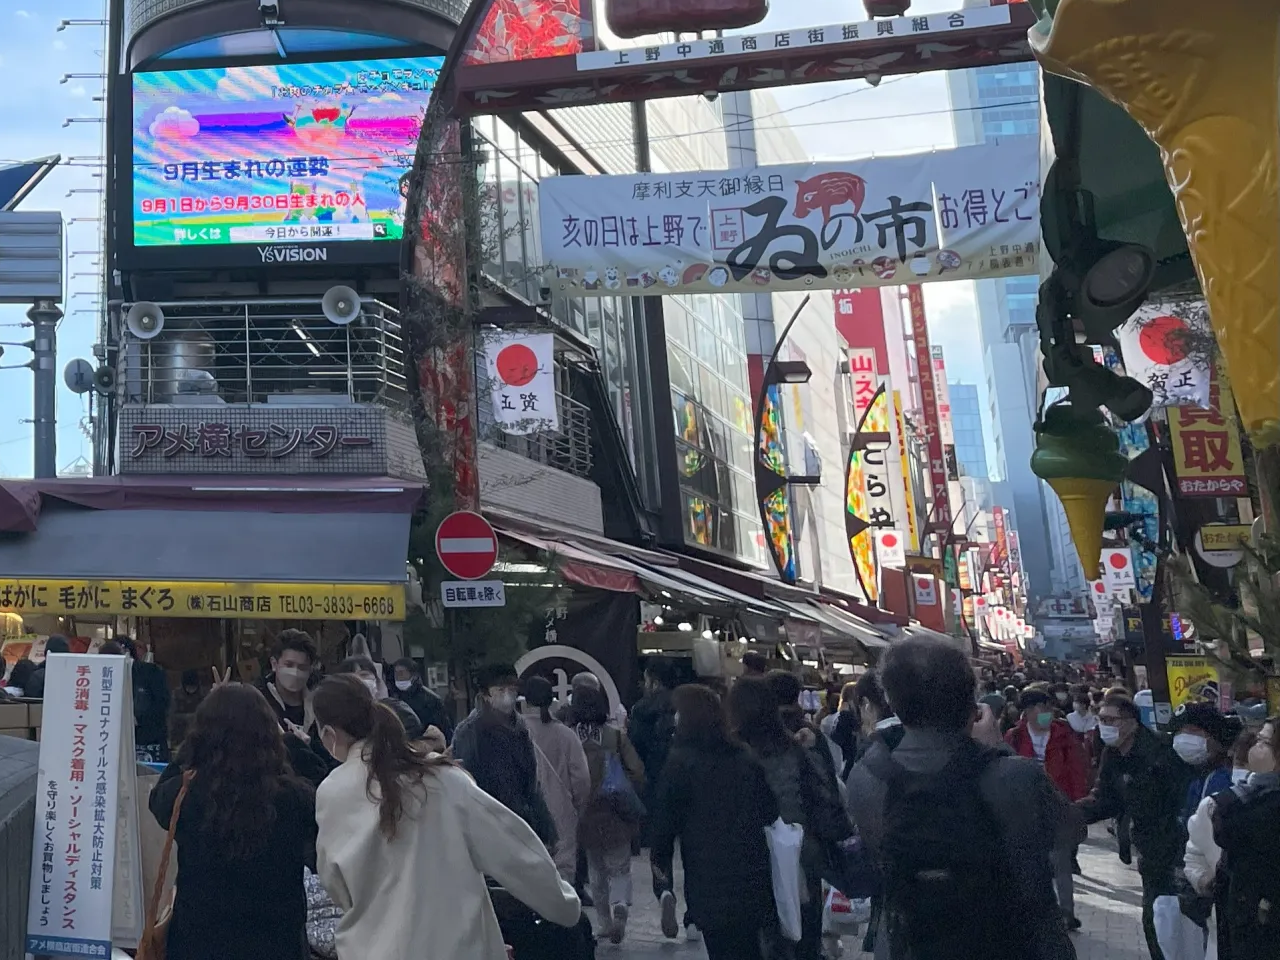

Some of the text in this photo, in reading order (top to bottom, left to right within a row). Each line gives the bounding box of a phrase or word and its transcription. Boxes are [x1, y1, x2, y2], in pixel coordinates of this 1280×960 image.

[613, 12, 967, 66] 上野中通商店街振興組合
[163, 156, 330, 181] 9月生まれの運勢
[631, 174, 785, 200] 摩利支天御縁日
[141, 193, 365, 213] 9月1日から9月30日生まれの人
[562, 214, 707, 249] 亥の日は上野で
[718, 213, 739, 245] 上野
[829, 244, 872, 261] INOICHI
[130, 422, 374, 459] アメ横センター
[1180, 479, 1245, 493] おたからや
[58, 584, 111, 609] 毛がに
[121, 587, 176, 611] まぐろ
[445, 586, 502, 602] 自転車を除く
[89, 665, 114, 890] 新型コロナウイルス感染拡大防止対策
[61, 665, 92, 930] 手の消毒・マスク着用・ソーシャルディスタンス
[39, 780, 59, 927] を守り楽しくお買物しましょう
